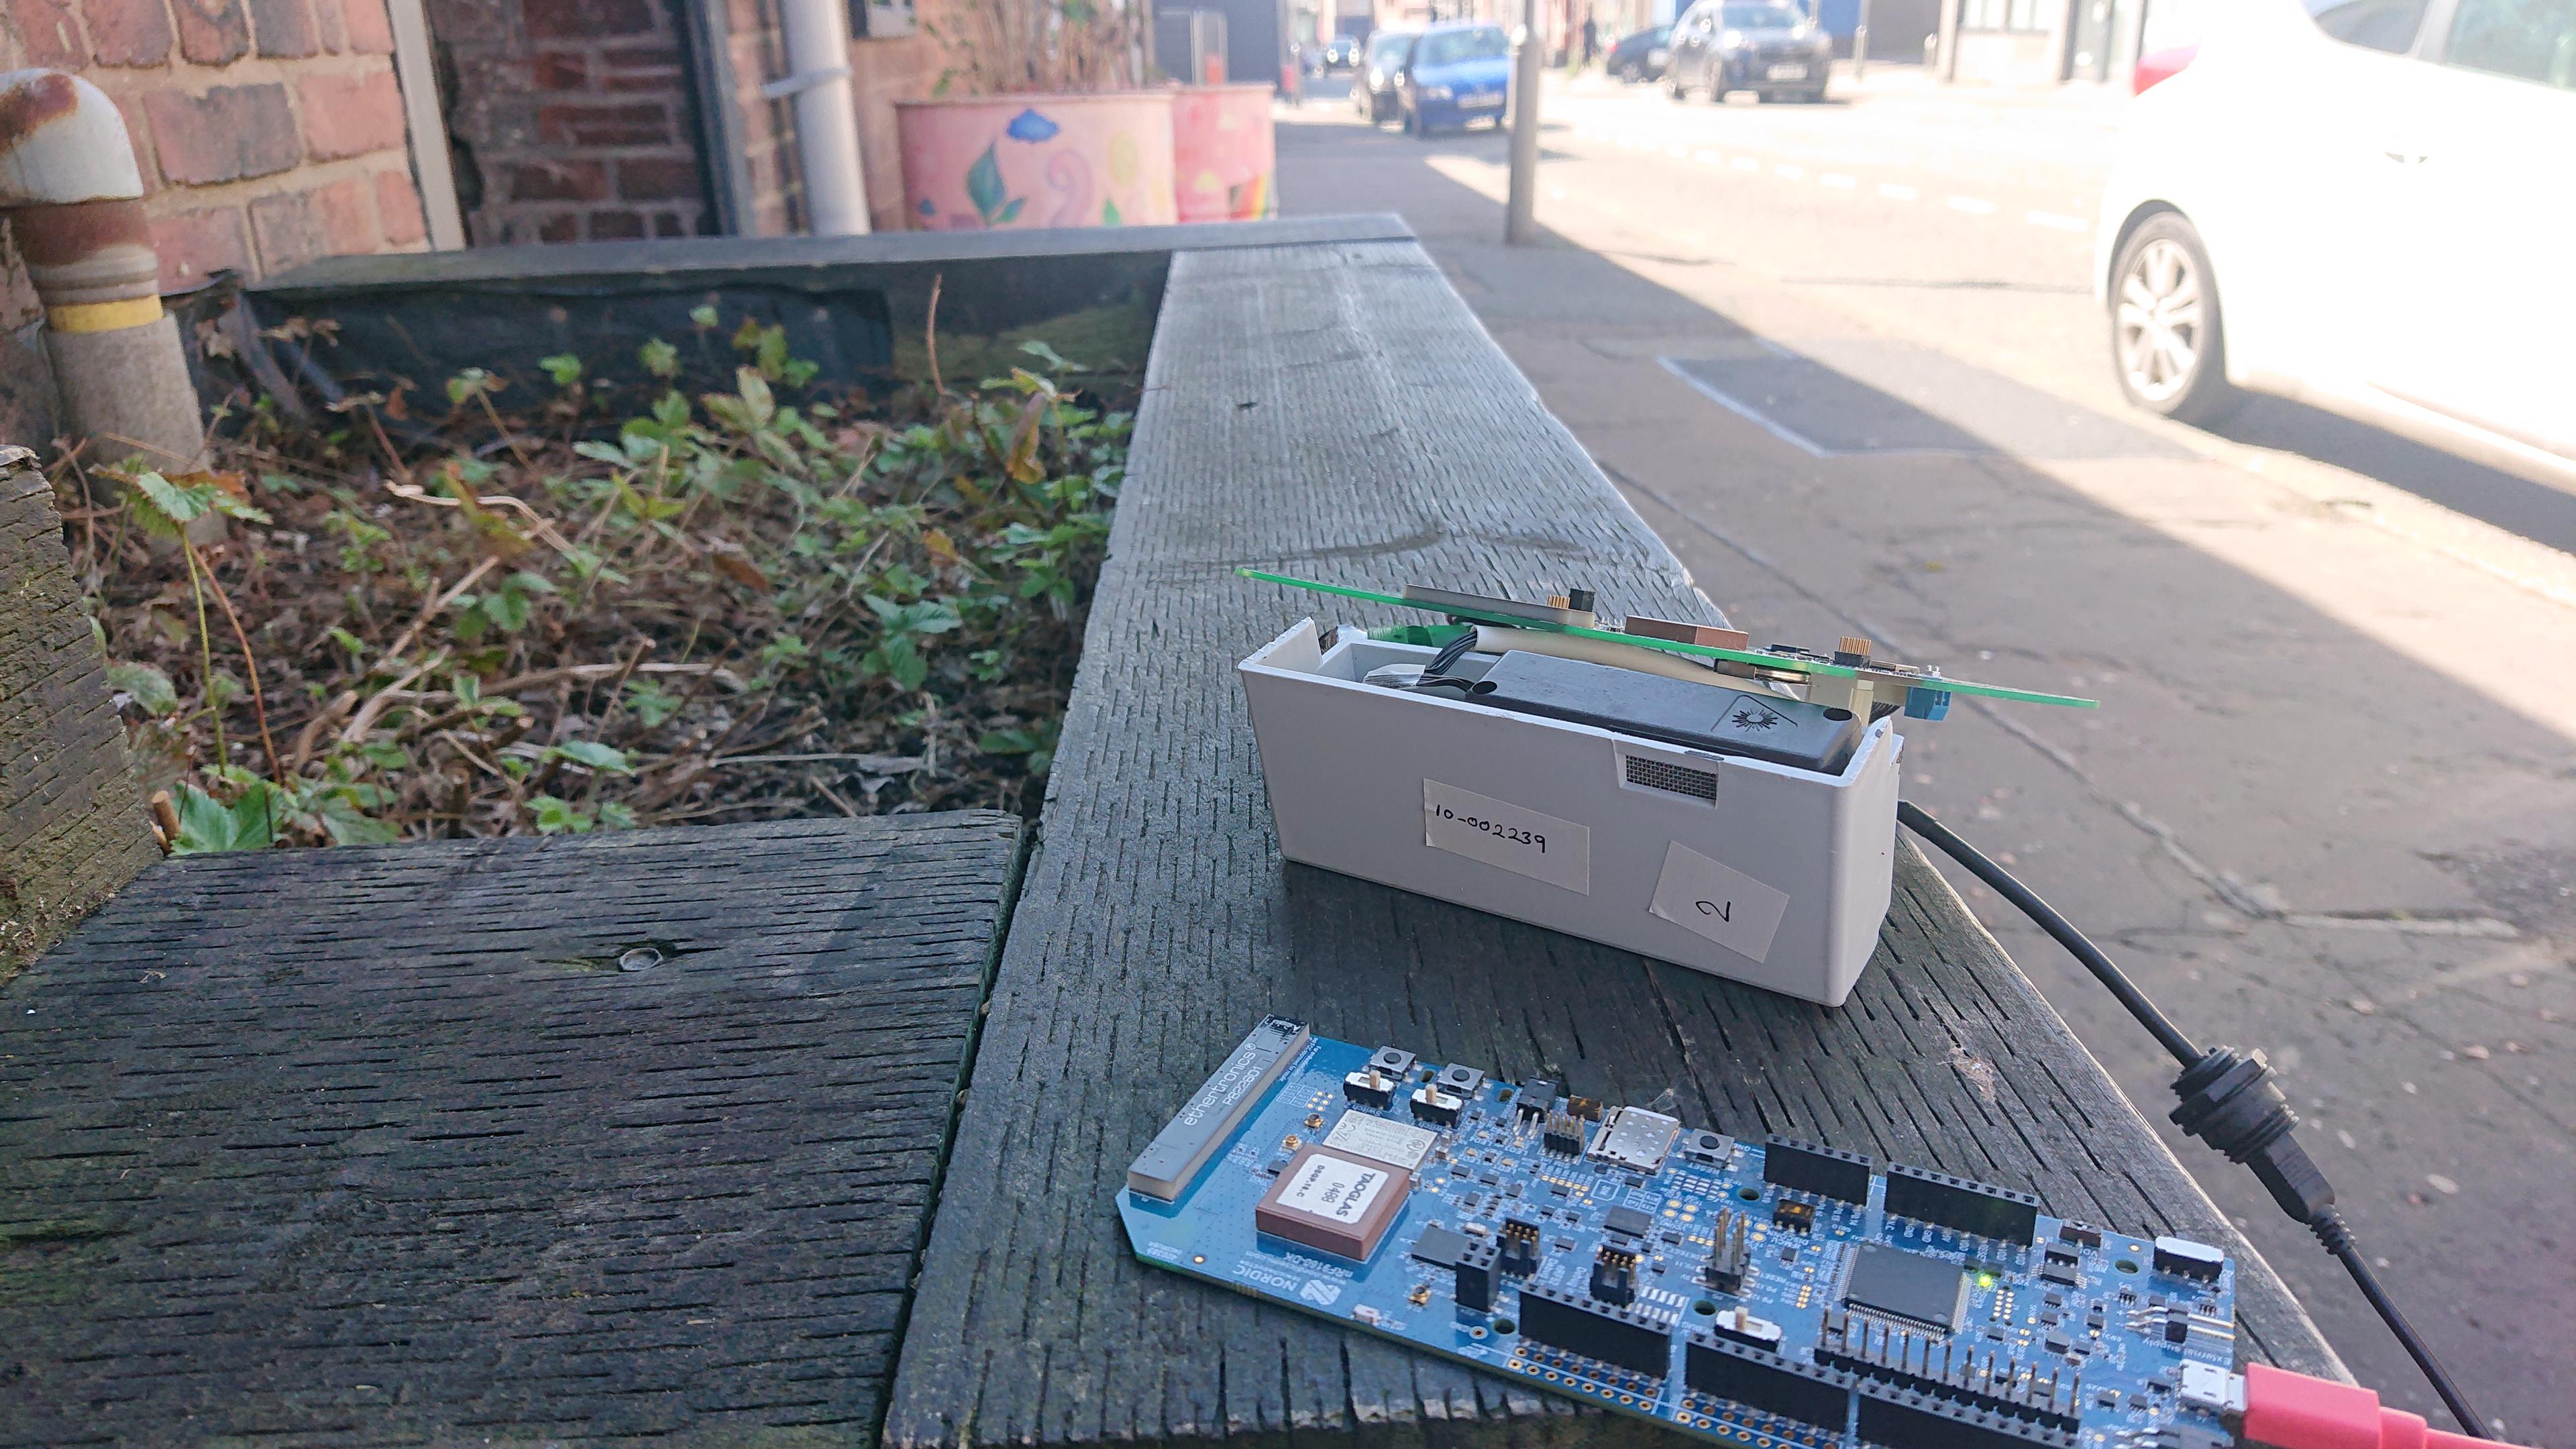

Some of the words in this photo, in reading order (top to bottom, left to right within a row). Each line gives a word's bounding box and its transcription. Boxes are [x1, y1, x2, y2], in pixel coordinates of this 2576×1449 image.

[1435, 804, 1546, 854] 10-002239
[1687, 1162, 1720, 1175] RESET
[1321, 1182, 1345, 1205] 0488
[1336, 1172, 1375, 1218] TAOGLAS
[1232, 1264, 1298, 1291] NORDIC
[2142, 1336, 2182, 1355] supply
[2183, 1346, 2231, 1368] External
